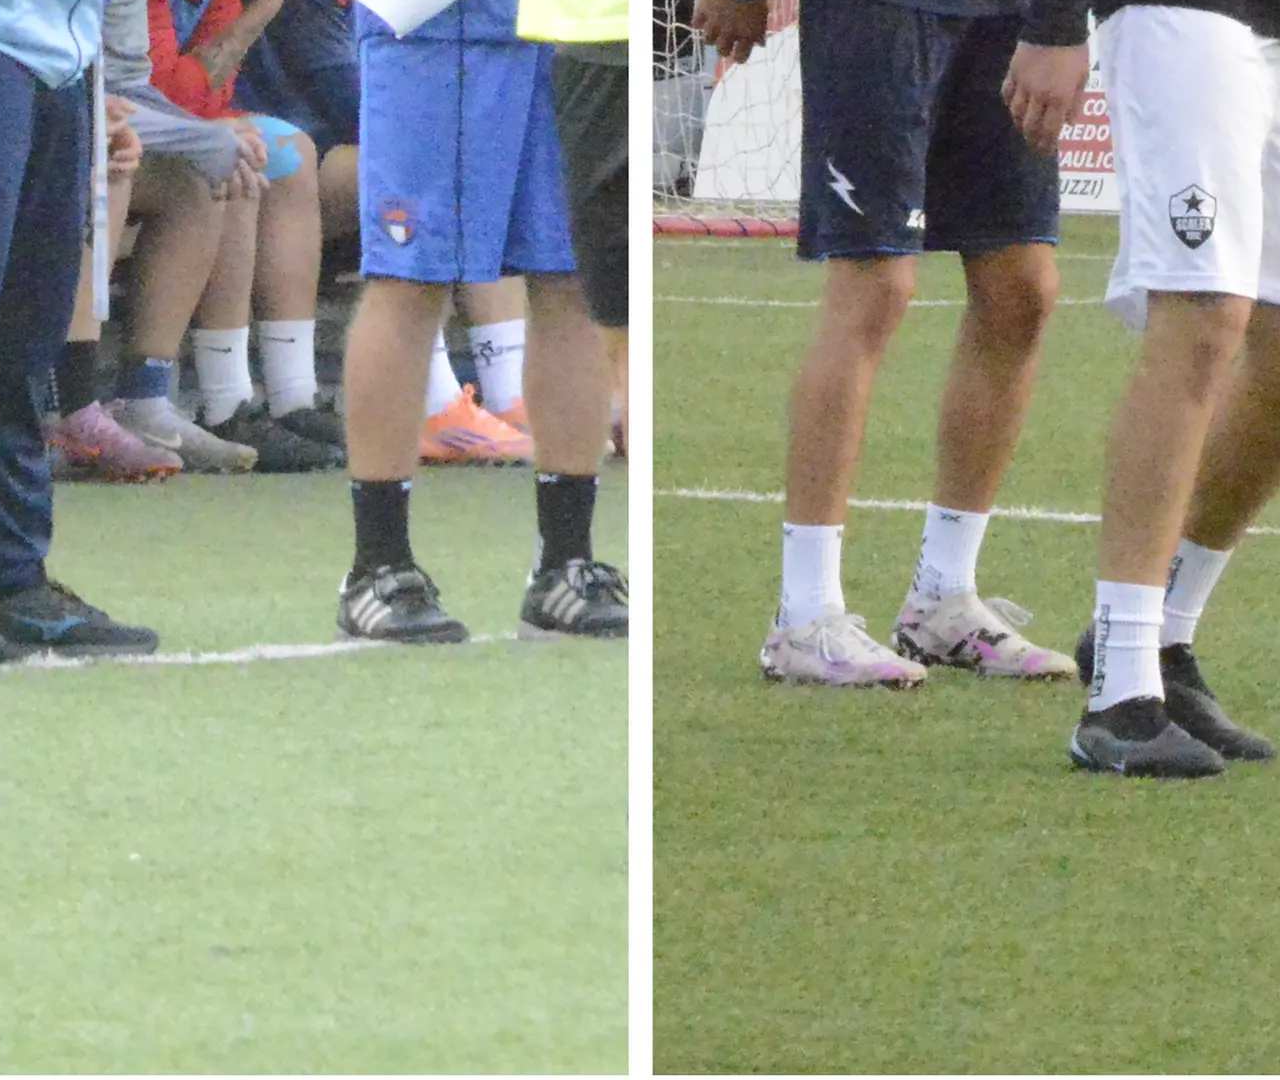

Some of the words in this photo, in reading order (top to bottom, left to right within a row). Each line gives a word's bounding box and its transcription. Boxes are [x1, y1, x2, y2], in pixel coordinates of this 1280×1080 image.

[1059, 124, 1109, 141] REDO
[1059, 151, 1113, 168] AULIC
[1059, 178, 1104, 199] UZZI)
